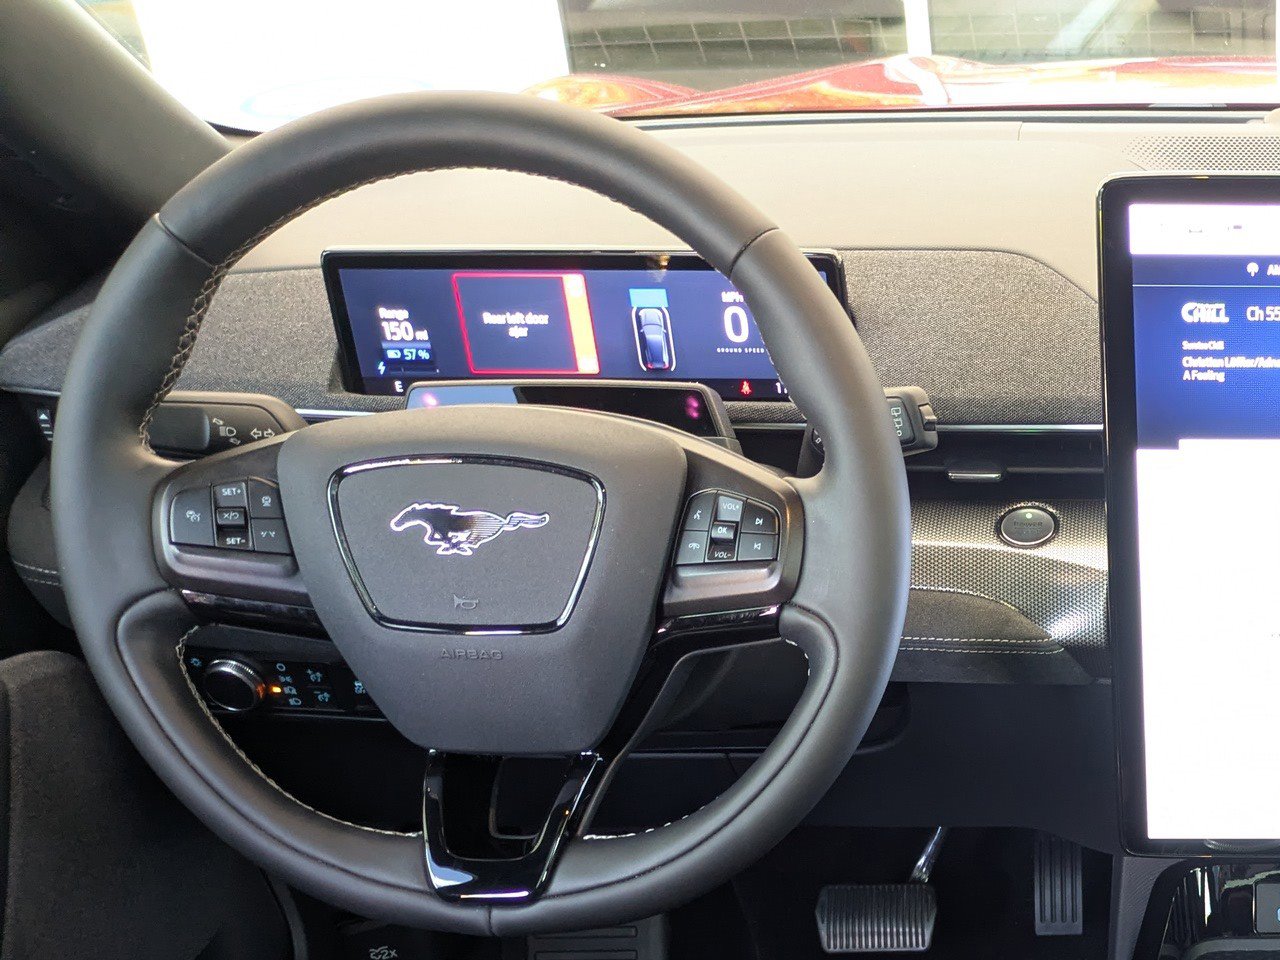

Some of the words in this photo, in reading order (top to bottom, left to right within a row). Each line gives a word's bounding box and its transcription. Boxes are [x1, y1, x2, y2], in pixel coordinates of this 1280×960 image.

[379, 307, 409, 321] Range
[482, 312, 506, 325] Rear
[506, 312, 525, 325] left
[525, 312, 549, 325] door
[1246, 306, 1264, 321] Ch
[382, 321, 414, 341] 150
[724, 306, 749, 343] 0
[508, 325, 528, 339] ajar
[403, 348, 416, 360] 57
[1183, 369, 1191, 380] A
[394, 380, 404, 393] E
[717, 526, 728, 534] OK
[440, 648, 503, 660] AIRBAG
